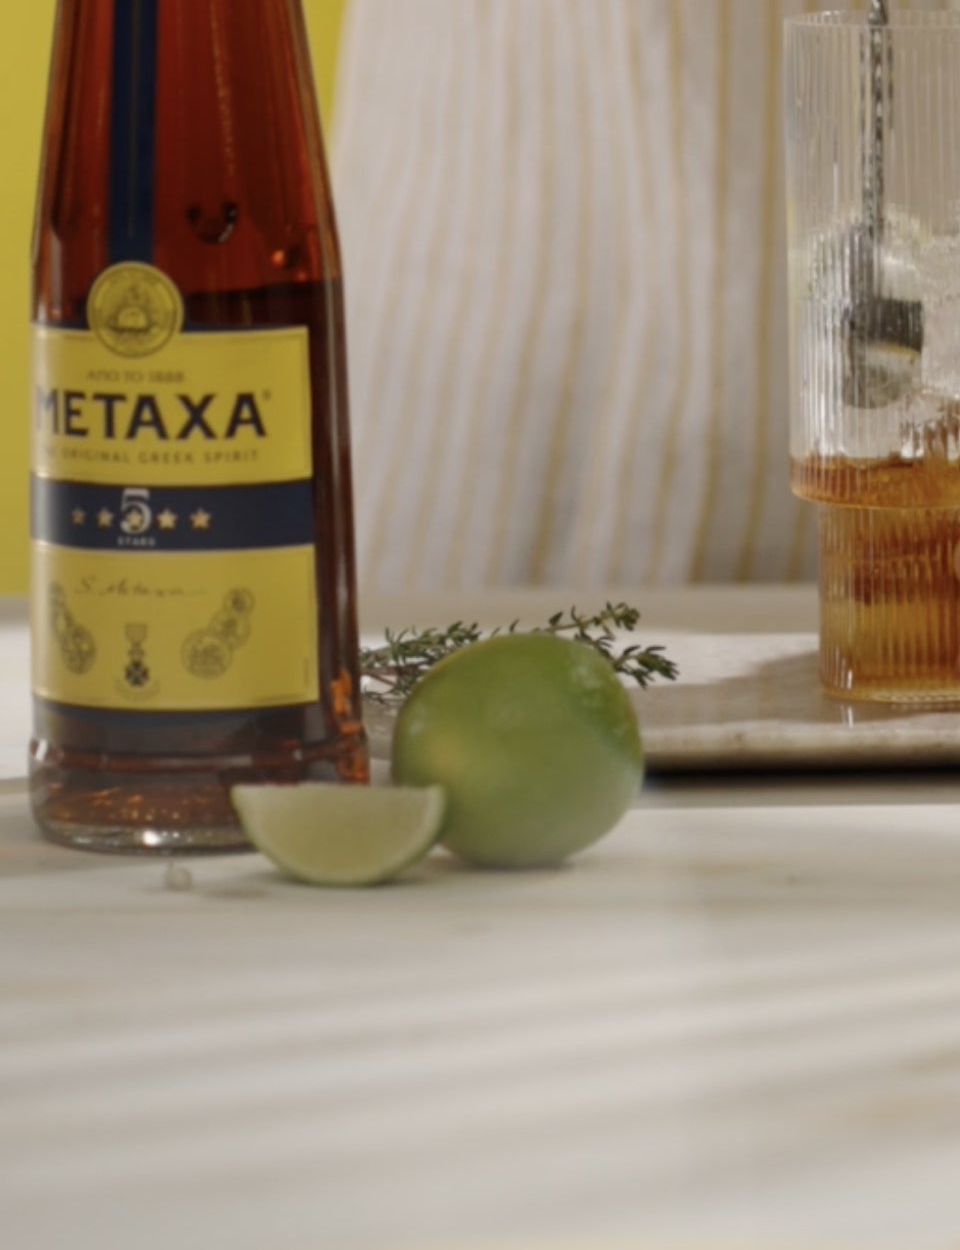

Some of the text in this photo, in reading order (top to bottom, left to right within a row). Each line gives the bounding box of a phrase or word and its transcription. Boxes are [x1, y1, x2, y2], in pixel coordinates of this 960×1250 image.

[138, 450, 193, 464] GREEK
[204, 449, 259, 463] SPIRIT
[120, 488, 152, 534] 5
